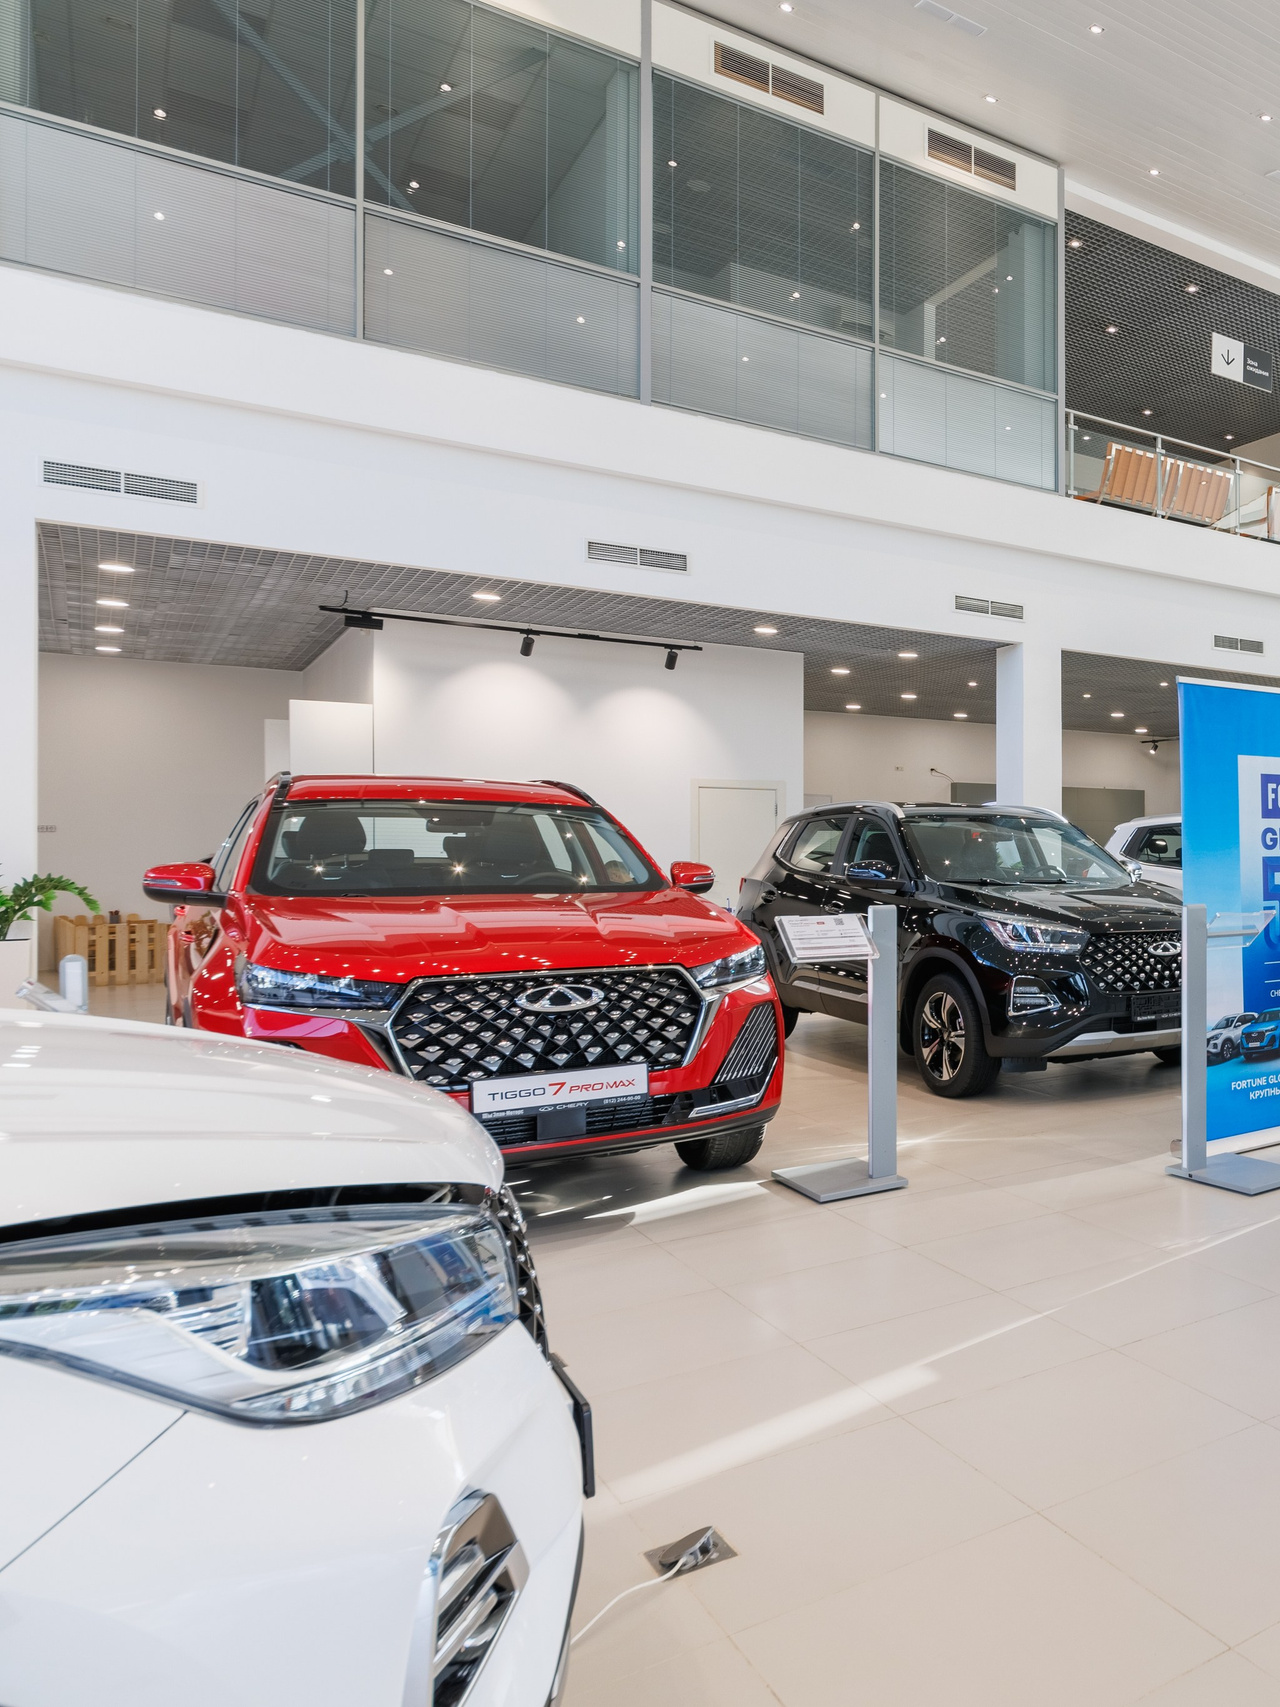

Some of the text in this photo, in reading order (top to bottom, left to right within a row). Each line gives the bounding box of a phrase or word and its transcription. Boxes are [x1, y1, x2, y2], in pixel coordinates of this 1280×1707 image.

[487, 1078, 635, 1101] TIGGO 7 PRO MAX
[1231, 1076, 1267, 1091] FORTUNE
[556, 1101, 590, 1110] CHERY
